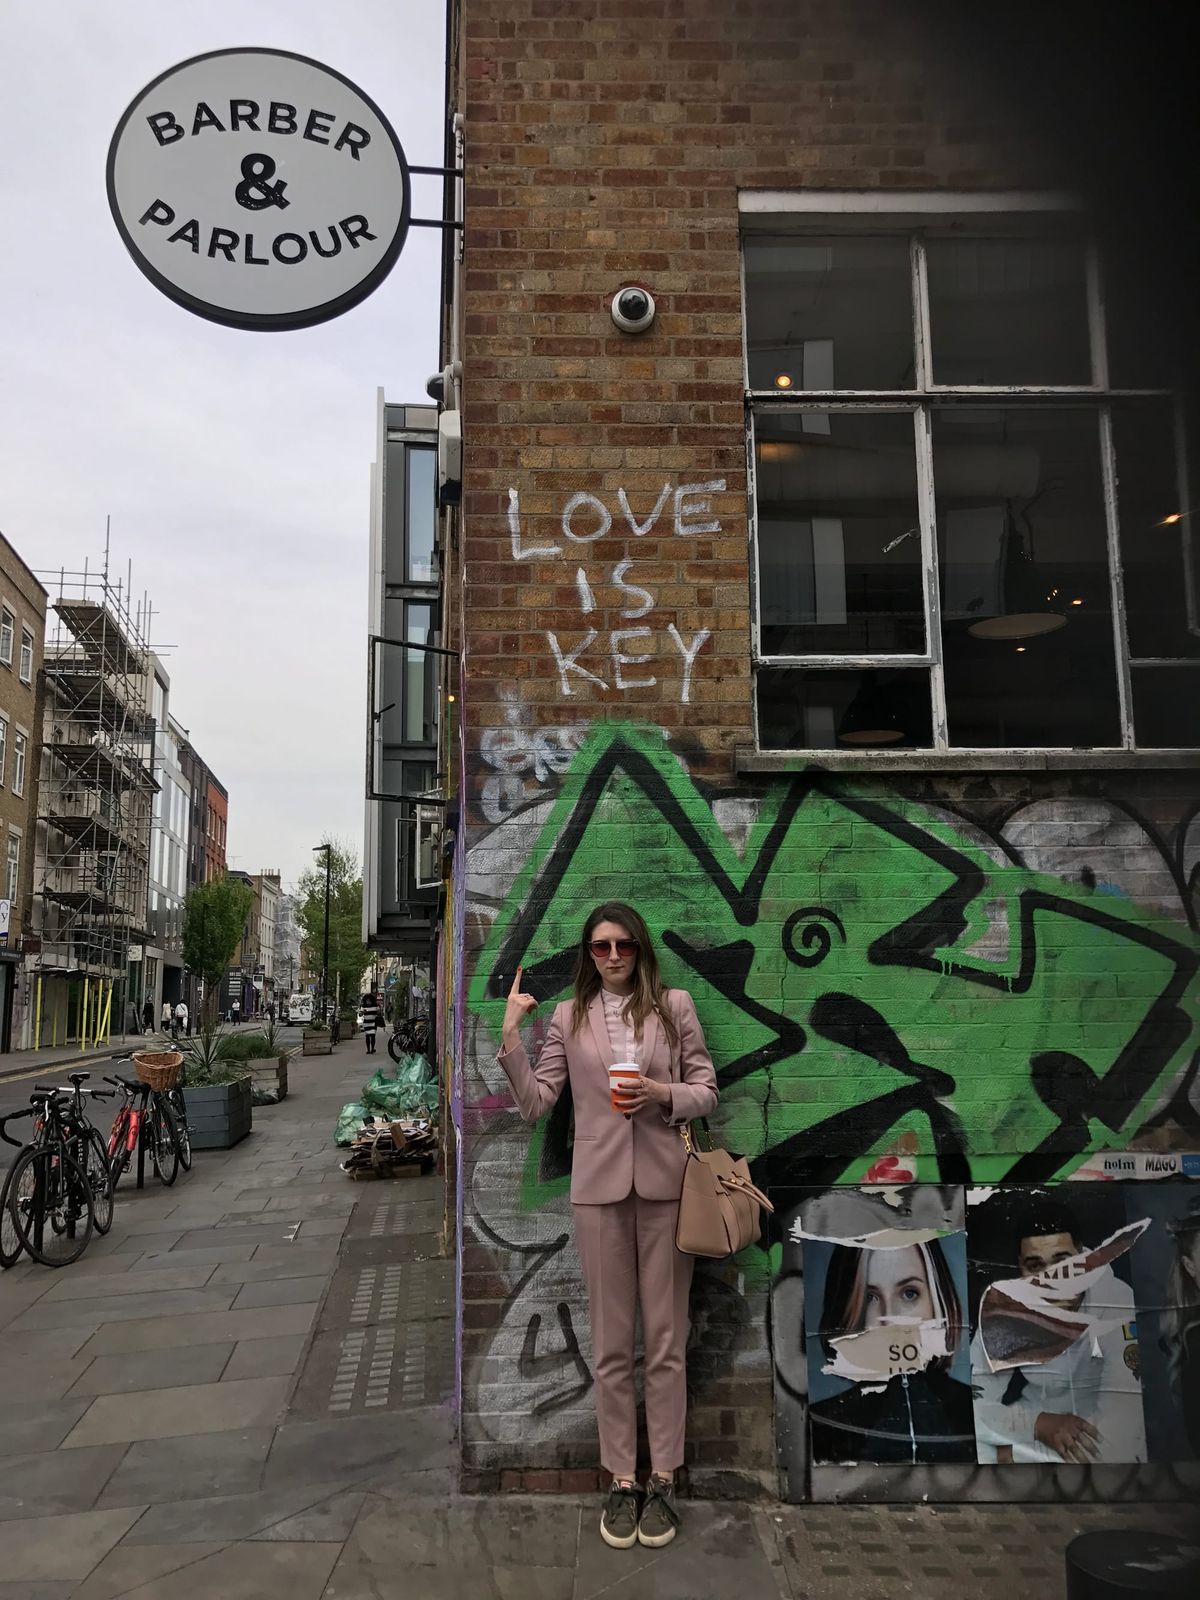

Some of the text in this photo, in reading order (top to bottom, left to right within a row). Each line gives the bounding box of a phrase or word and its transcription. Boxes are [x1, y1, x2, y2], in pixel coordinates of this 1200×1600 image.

[146, 98, 372, 162] BARBER
[234, 152, 291, 211] &
[138, 198, 378, 266] PARLOUR
[508, 479, 728, 560] LOVE
[575, 559, 655, 619] IS
[547, 622, 711, 705] KEY
[888, 1344, 919, 1362] SO
